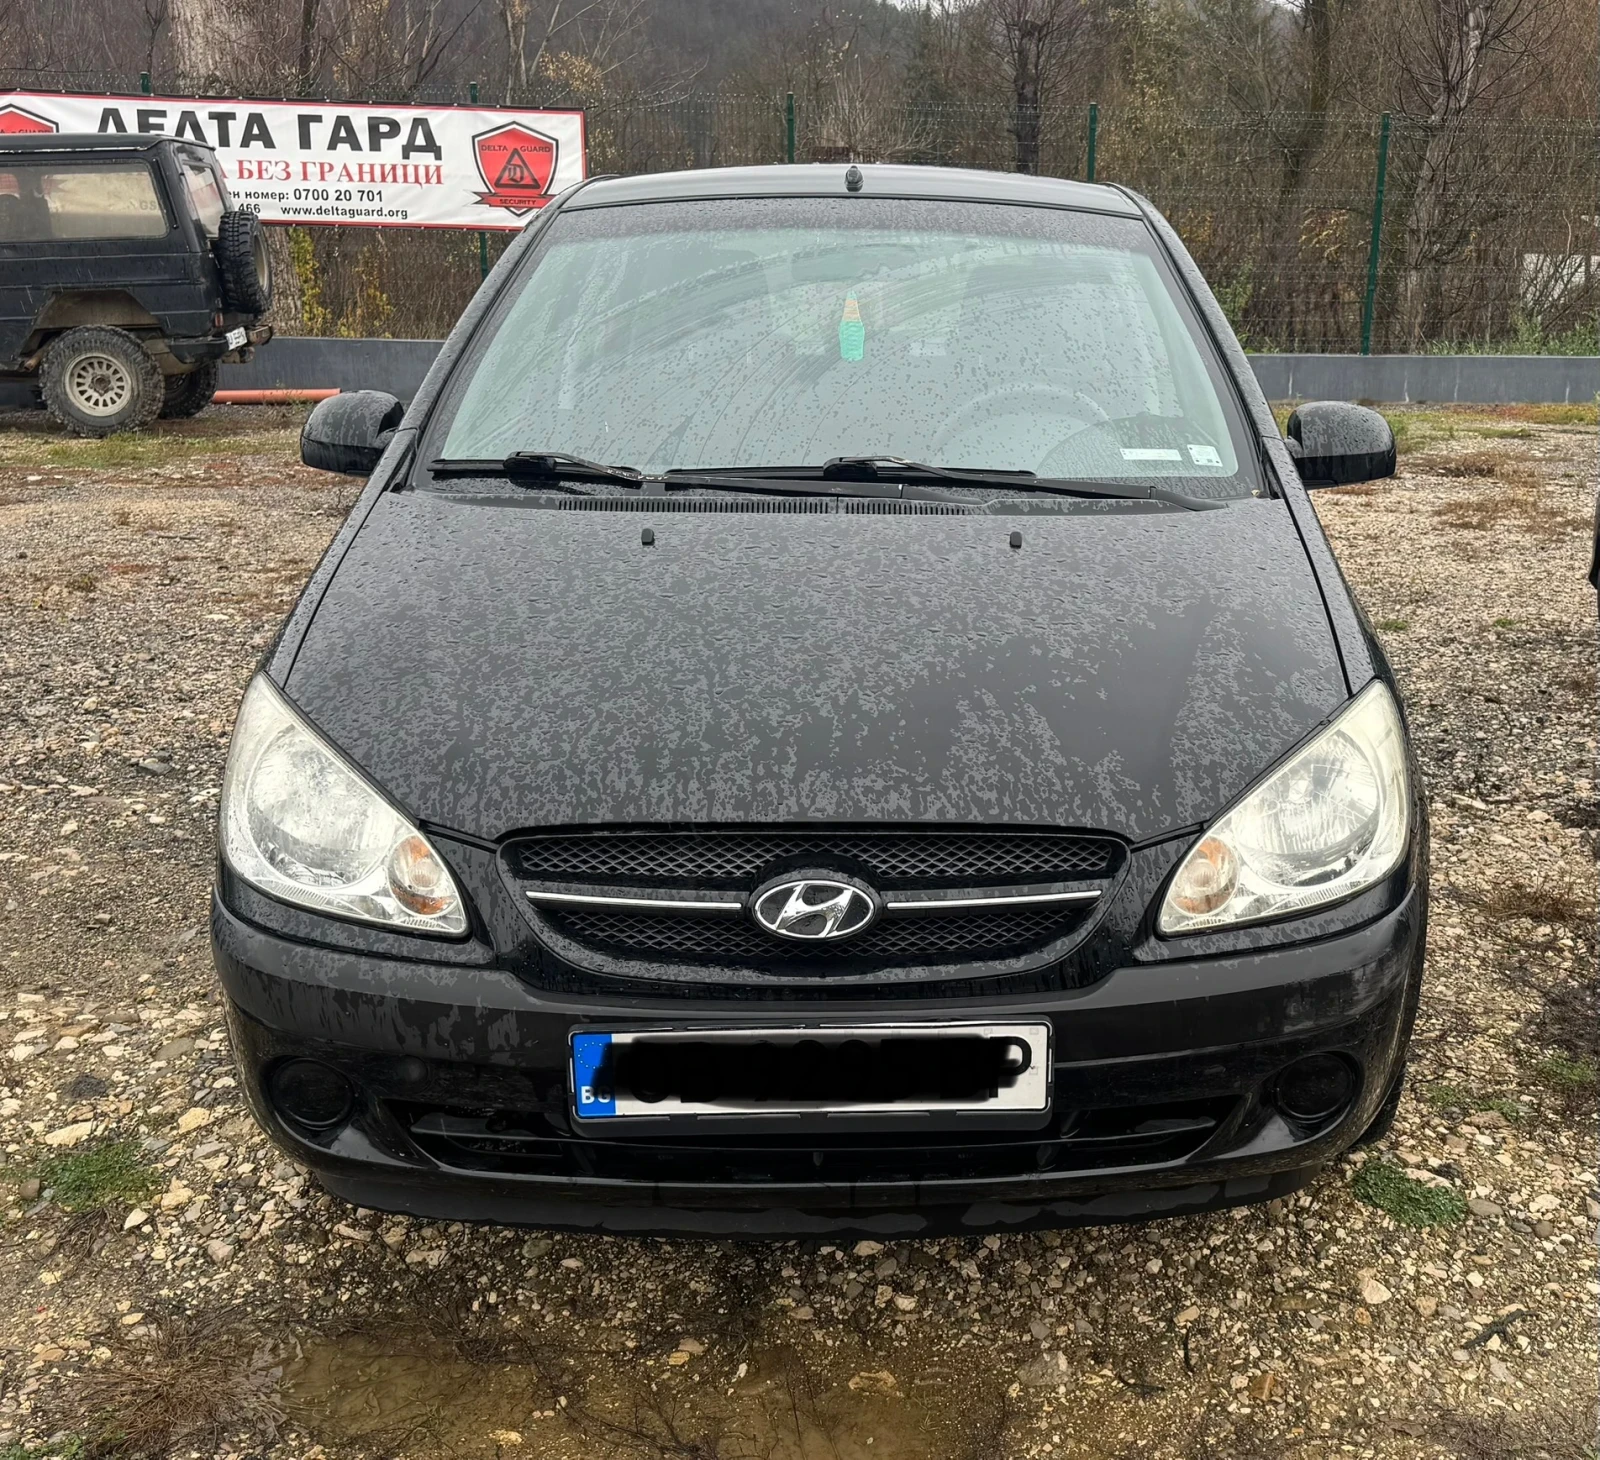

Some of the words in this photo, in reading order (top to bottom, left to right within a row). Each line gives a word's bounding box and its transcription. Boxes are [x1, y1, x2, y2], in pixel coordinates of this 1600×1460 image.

[297, 113, 443, 161] ГАРД
[481, 144, 509, 152] DELTA
[519, 145, 552, 153] GUARD
[236, 159, 292, 181] БЕЗ
[300, 161, 444, 189] ГРАНИЦИ
[244, 190, 290, 202] номер:
[293, 188, 330, 202] 0700
[334, 189, 352, 202] 20
[356, 190, 384, 203] 701
[280, 204, 409, 221] www.deltaguard.org
